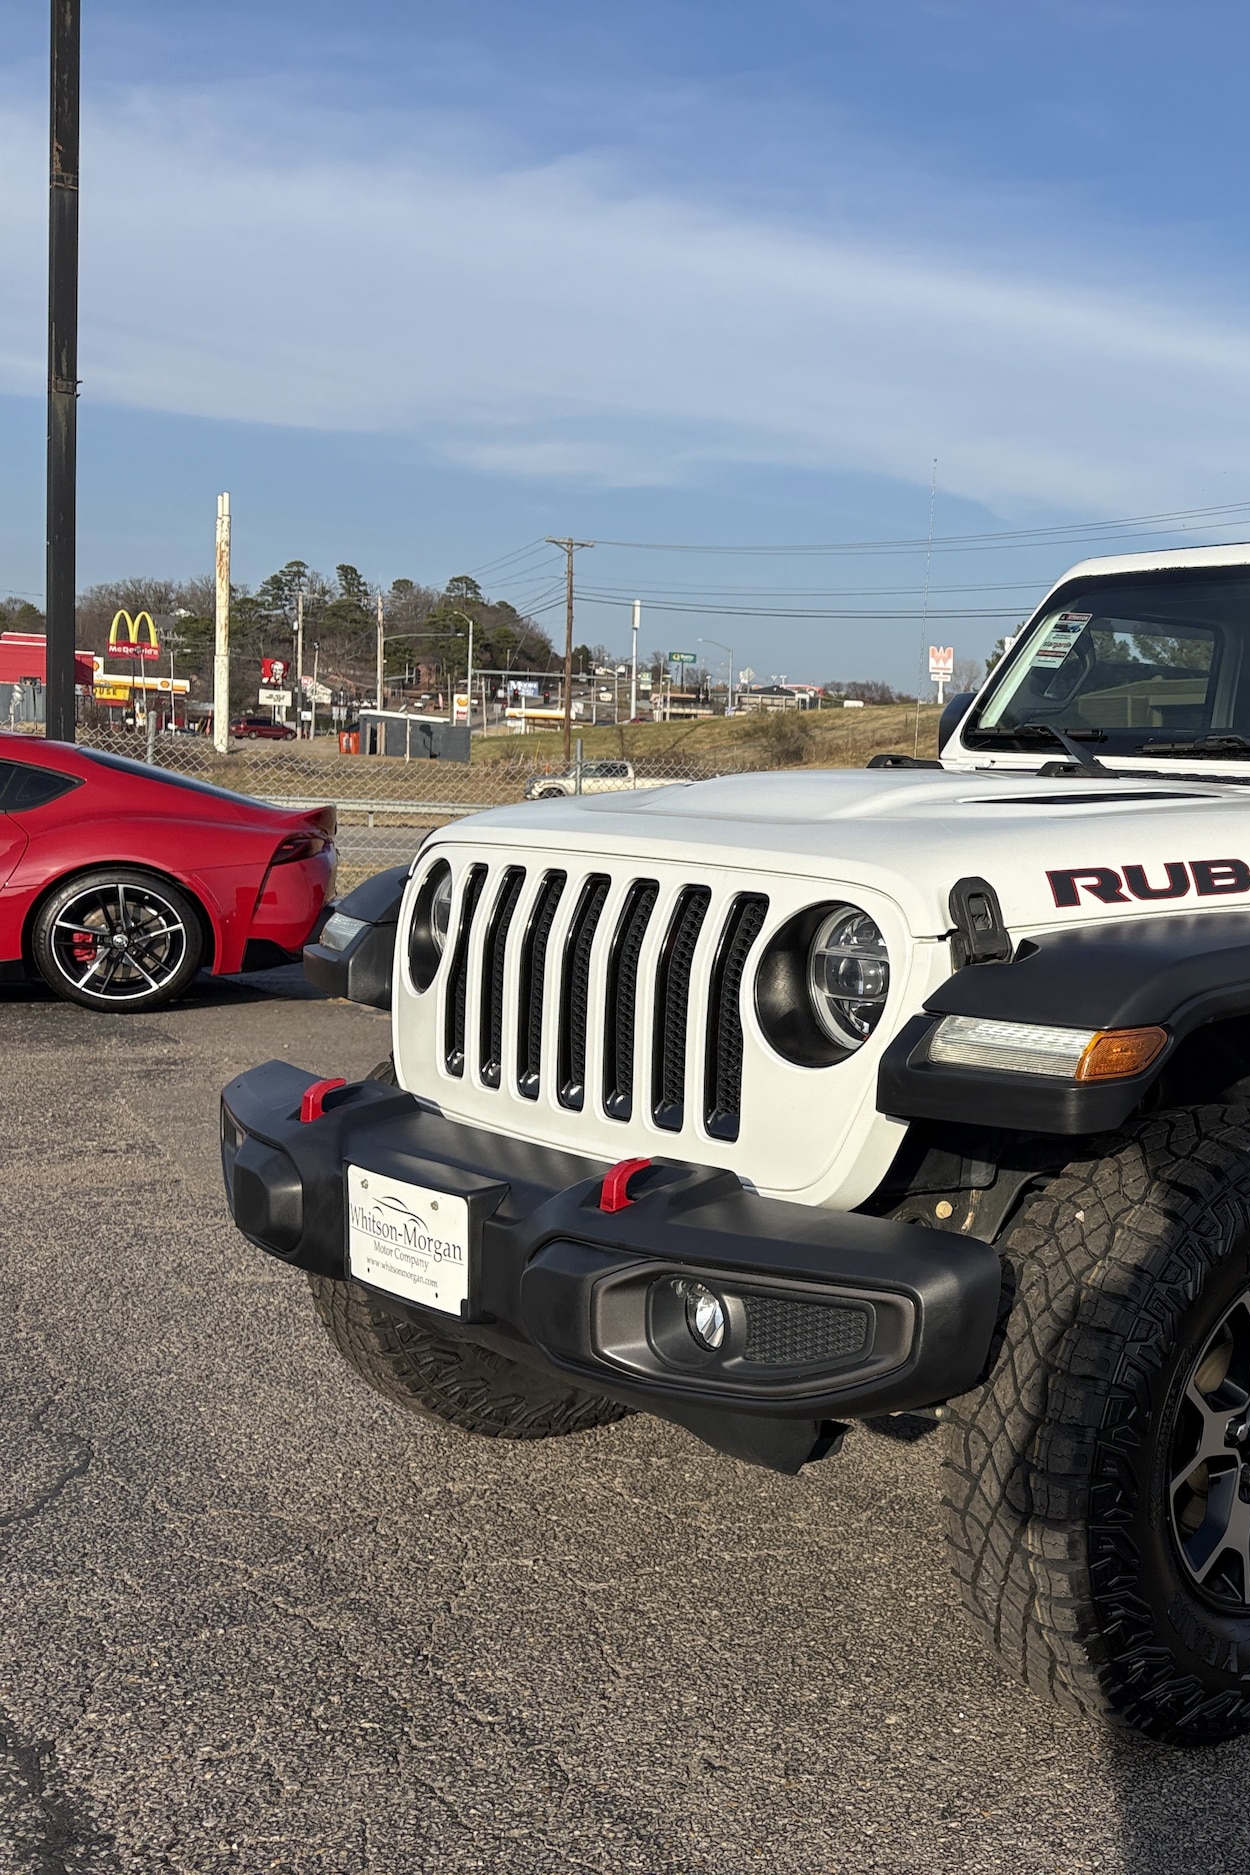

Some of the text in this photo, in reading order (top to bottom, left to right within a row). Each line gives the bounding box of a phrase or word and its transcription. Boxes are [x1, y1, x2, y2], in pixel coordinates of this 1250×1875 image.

[109, 645, 159, 656] McDold's
[350, 1203, 463, 1263] Whitson-Morgan
[373, 1240, 429, 1272] Motor Company
